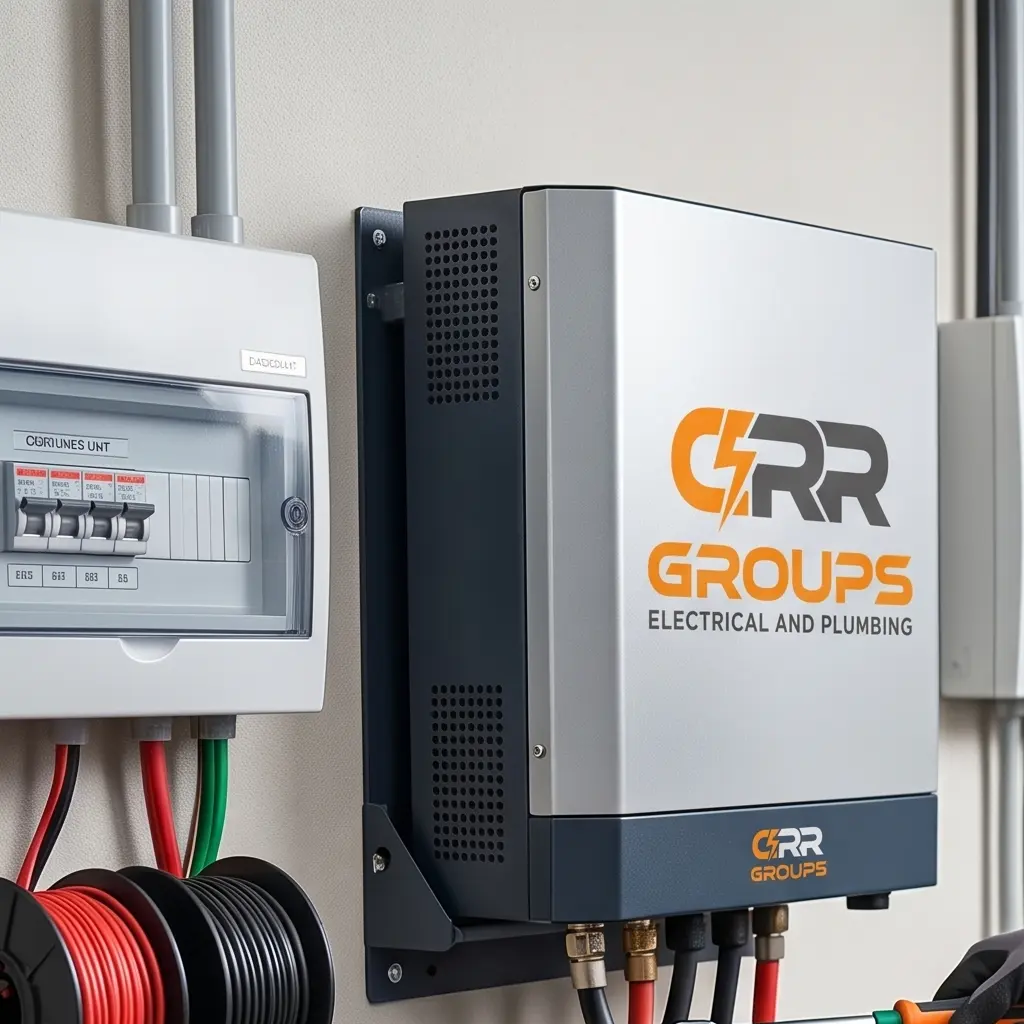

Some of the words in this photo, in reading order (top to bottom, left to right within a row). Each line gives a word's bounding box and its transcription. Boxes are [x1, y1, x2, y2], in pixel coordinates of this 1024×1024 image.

[671, 406, 891, 532] CRR
[648, 541, 913, 606] GROUPS
[648, 609, 769, 633] ELECTRICAL
[775, 613, 814, 634] AND
[821, 615, 913, 636] PLUMBING
[752, 826, 824, 861] CRR
[751, 860, 828, 882] GROUPS
